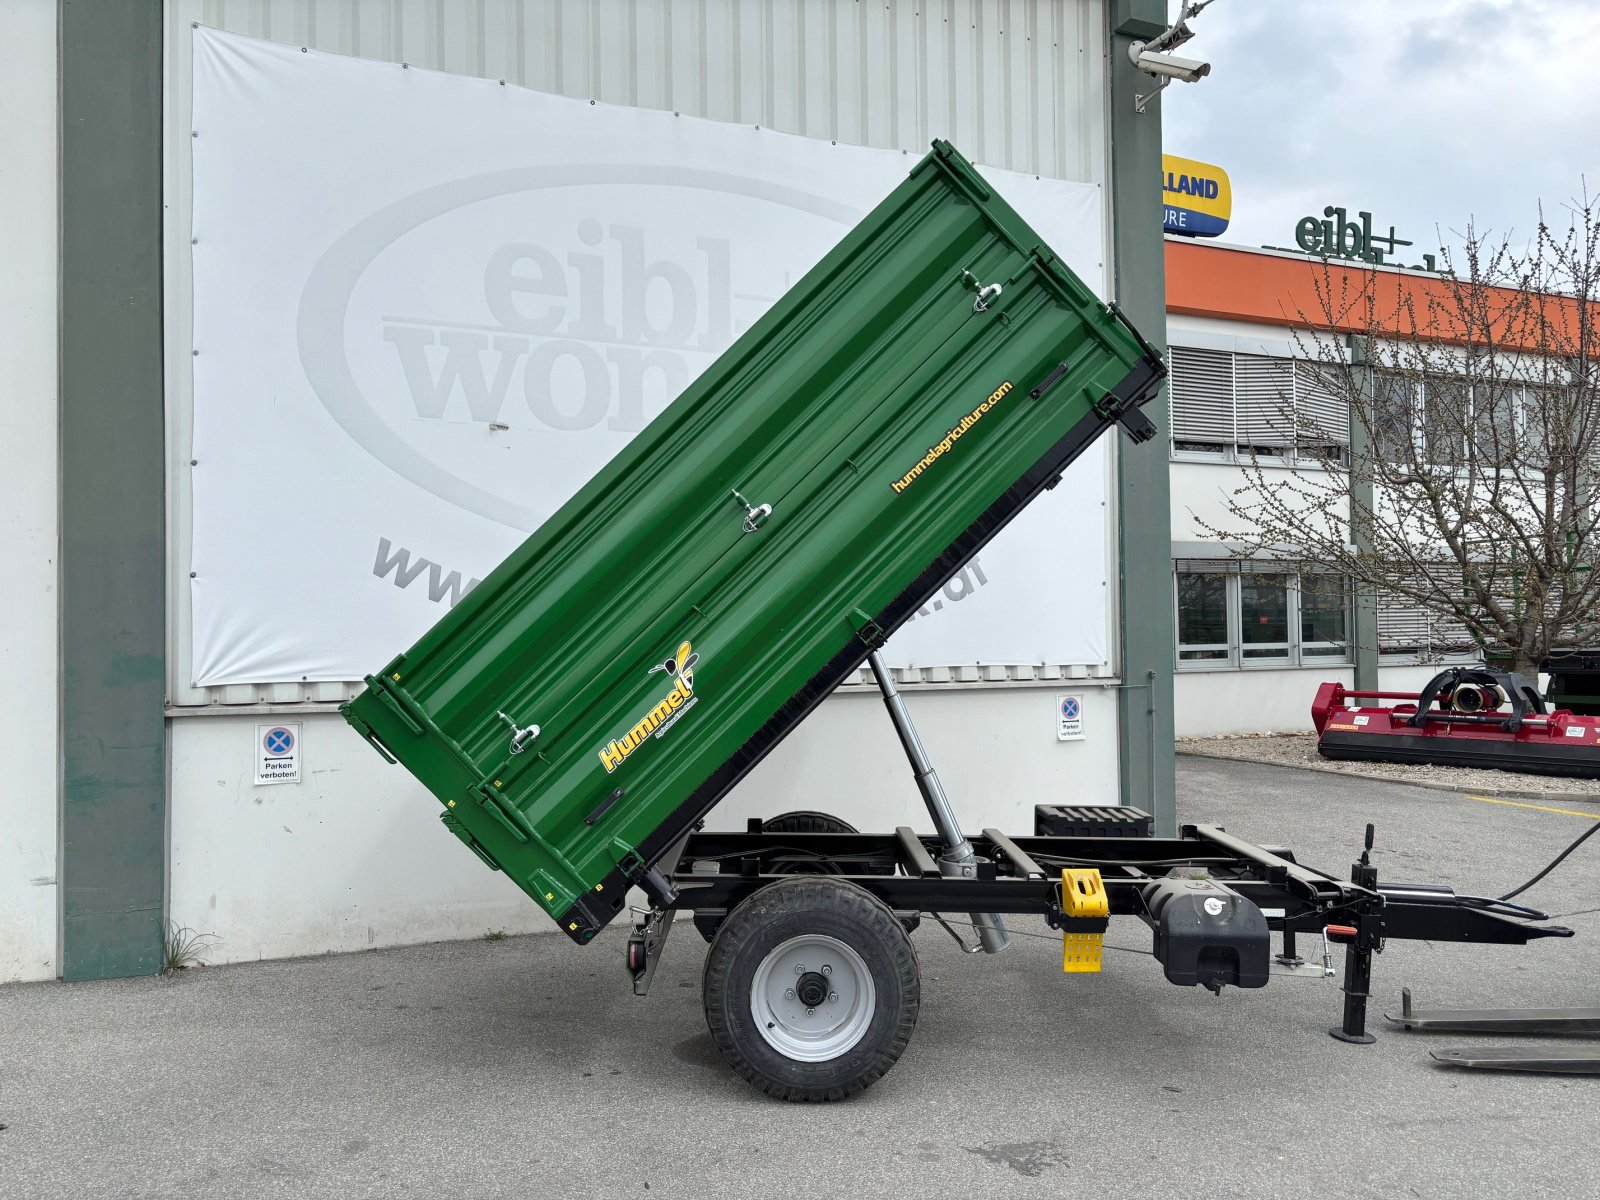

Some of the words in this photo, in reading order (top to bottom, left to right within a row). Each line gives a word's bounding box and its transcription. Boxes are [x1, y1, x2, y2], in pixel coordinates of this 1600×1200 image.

[382, 325, 692, 433] won
[890, 380, 1014, 494] hummelagriculture.com
[265, 762, 293, 770] Parken
[598, 677, 693, 773] Hummel
[260, 770, 297, 779] verboten!
